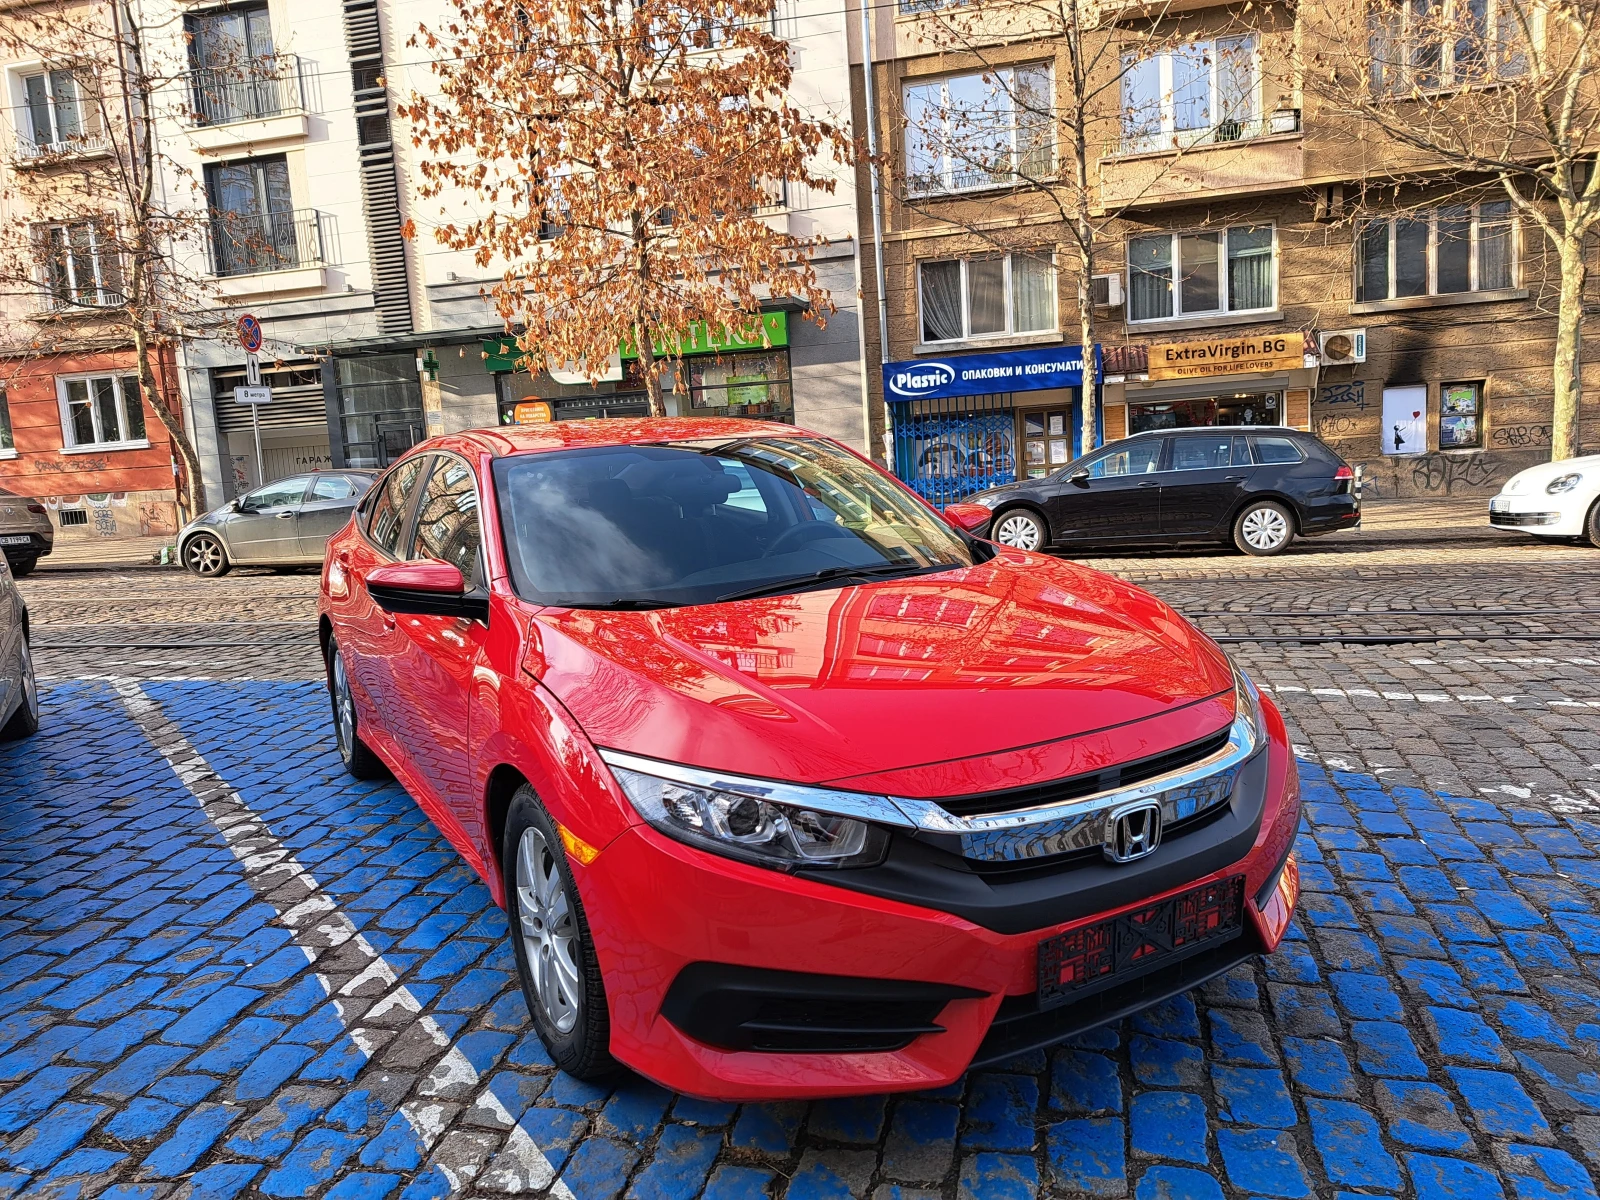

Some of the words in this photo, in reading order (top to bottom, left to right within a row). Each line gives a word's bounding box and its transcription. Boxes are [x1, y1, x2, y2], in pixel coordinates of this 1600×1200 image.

[1165, 339, 1285, 361] ExtraVirgin.BG
[961, 367, 1013, 381] ОПАКОВКИ
[1015, 364, 1022, 376] И
[1177, 367, 1198, 375] OLIVE
[1200, 365, 1211, 373] OIL
[1213, 364, 1228, 372] FOR
[1229, 363, 1244, 371] LIFE
[1245, 361, 1274, 369] LOVERS
[897, 369, 948, 389] Plastic
[244, 390, 249, 398] 8
[296, 455, 333, 465] ГАРАЖ
